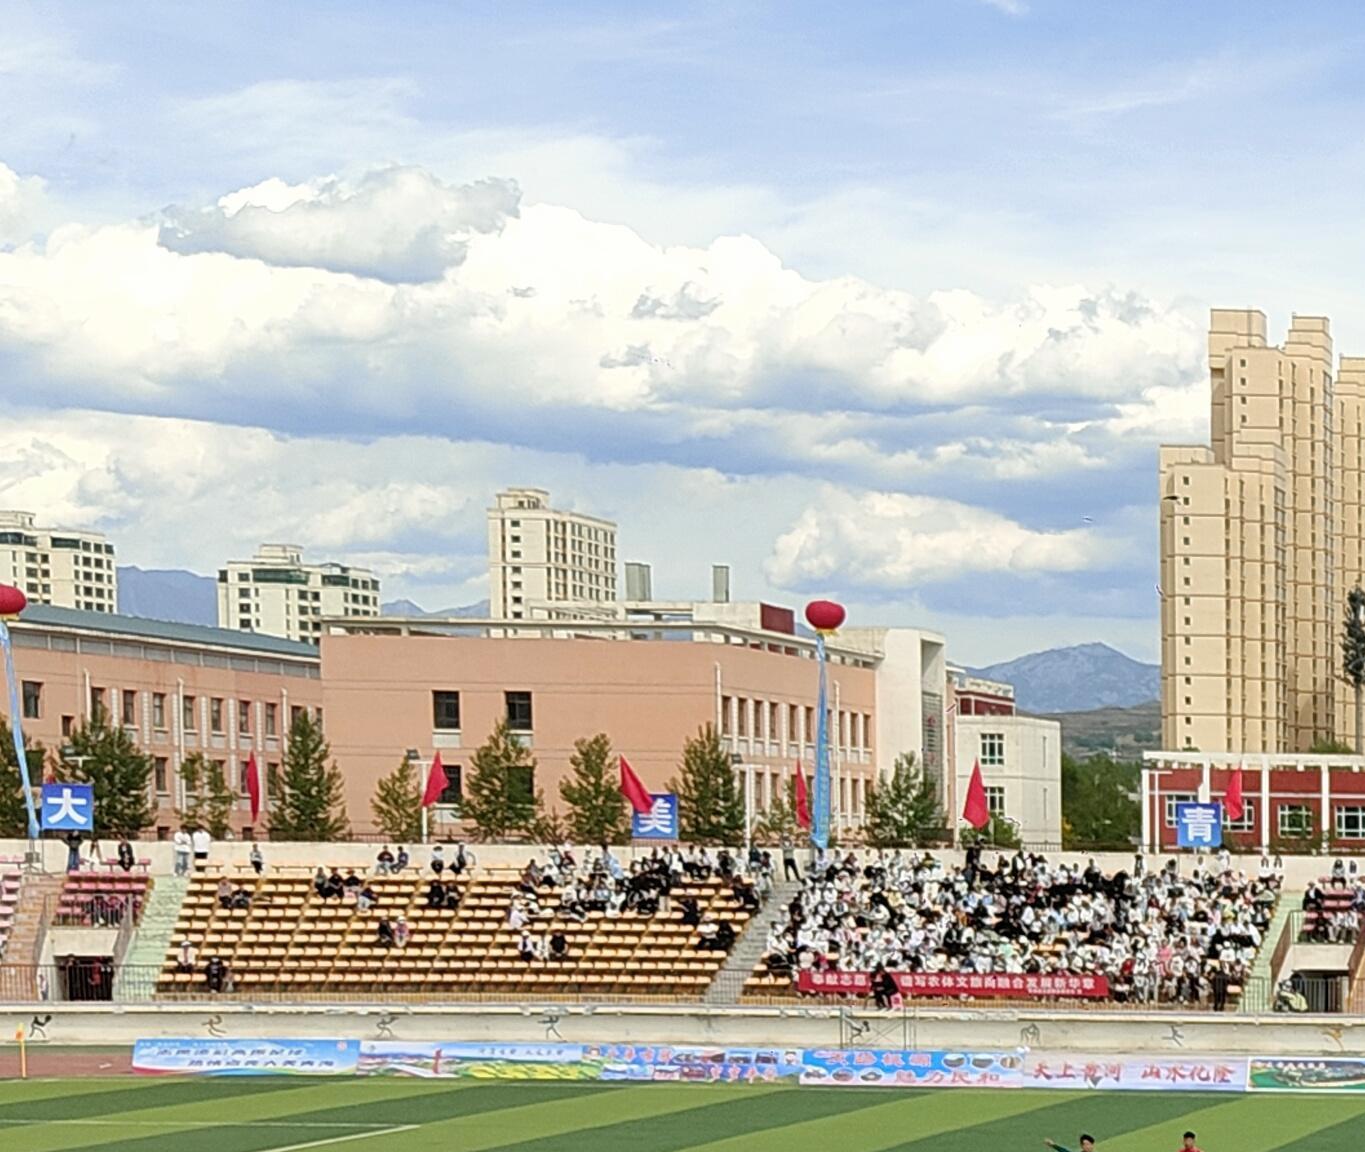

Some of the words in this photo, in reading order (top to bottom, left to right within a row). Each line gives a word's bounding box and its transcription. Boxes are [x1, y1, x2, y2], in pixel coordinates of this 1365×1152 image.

[47, 788, 88, 825] 大
[638, 797, 673, 834] 美
[1181, 806, 1217, 843] 青
